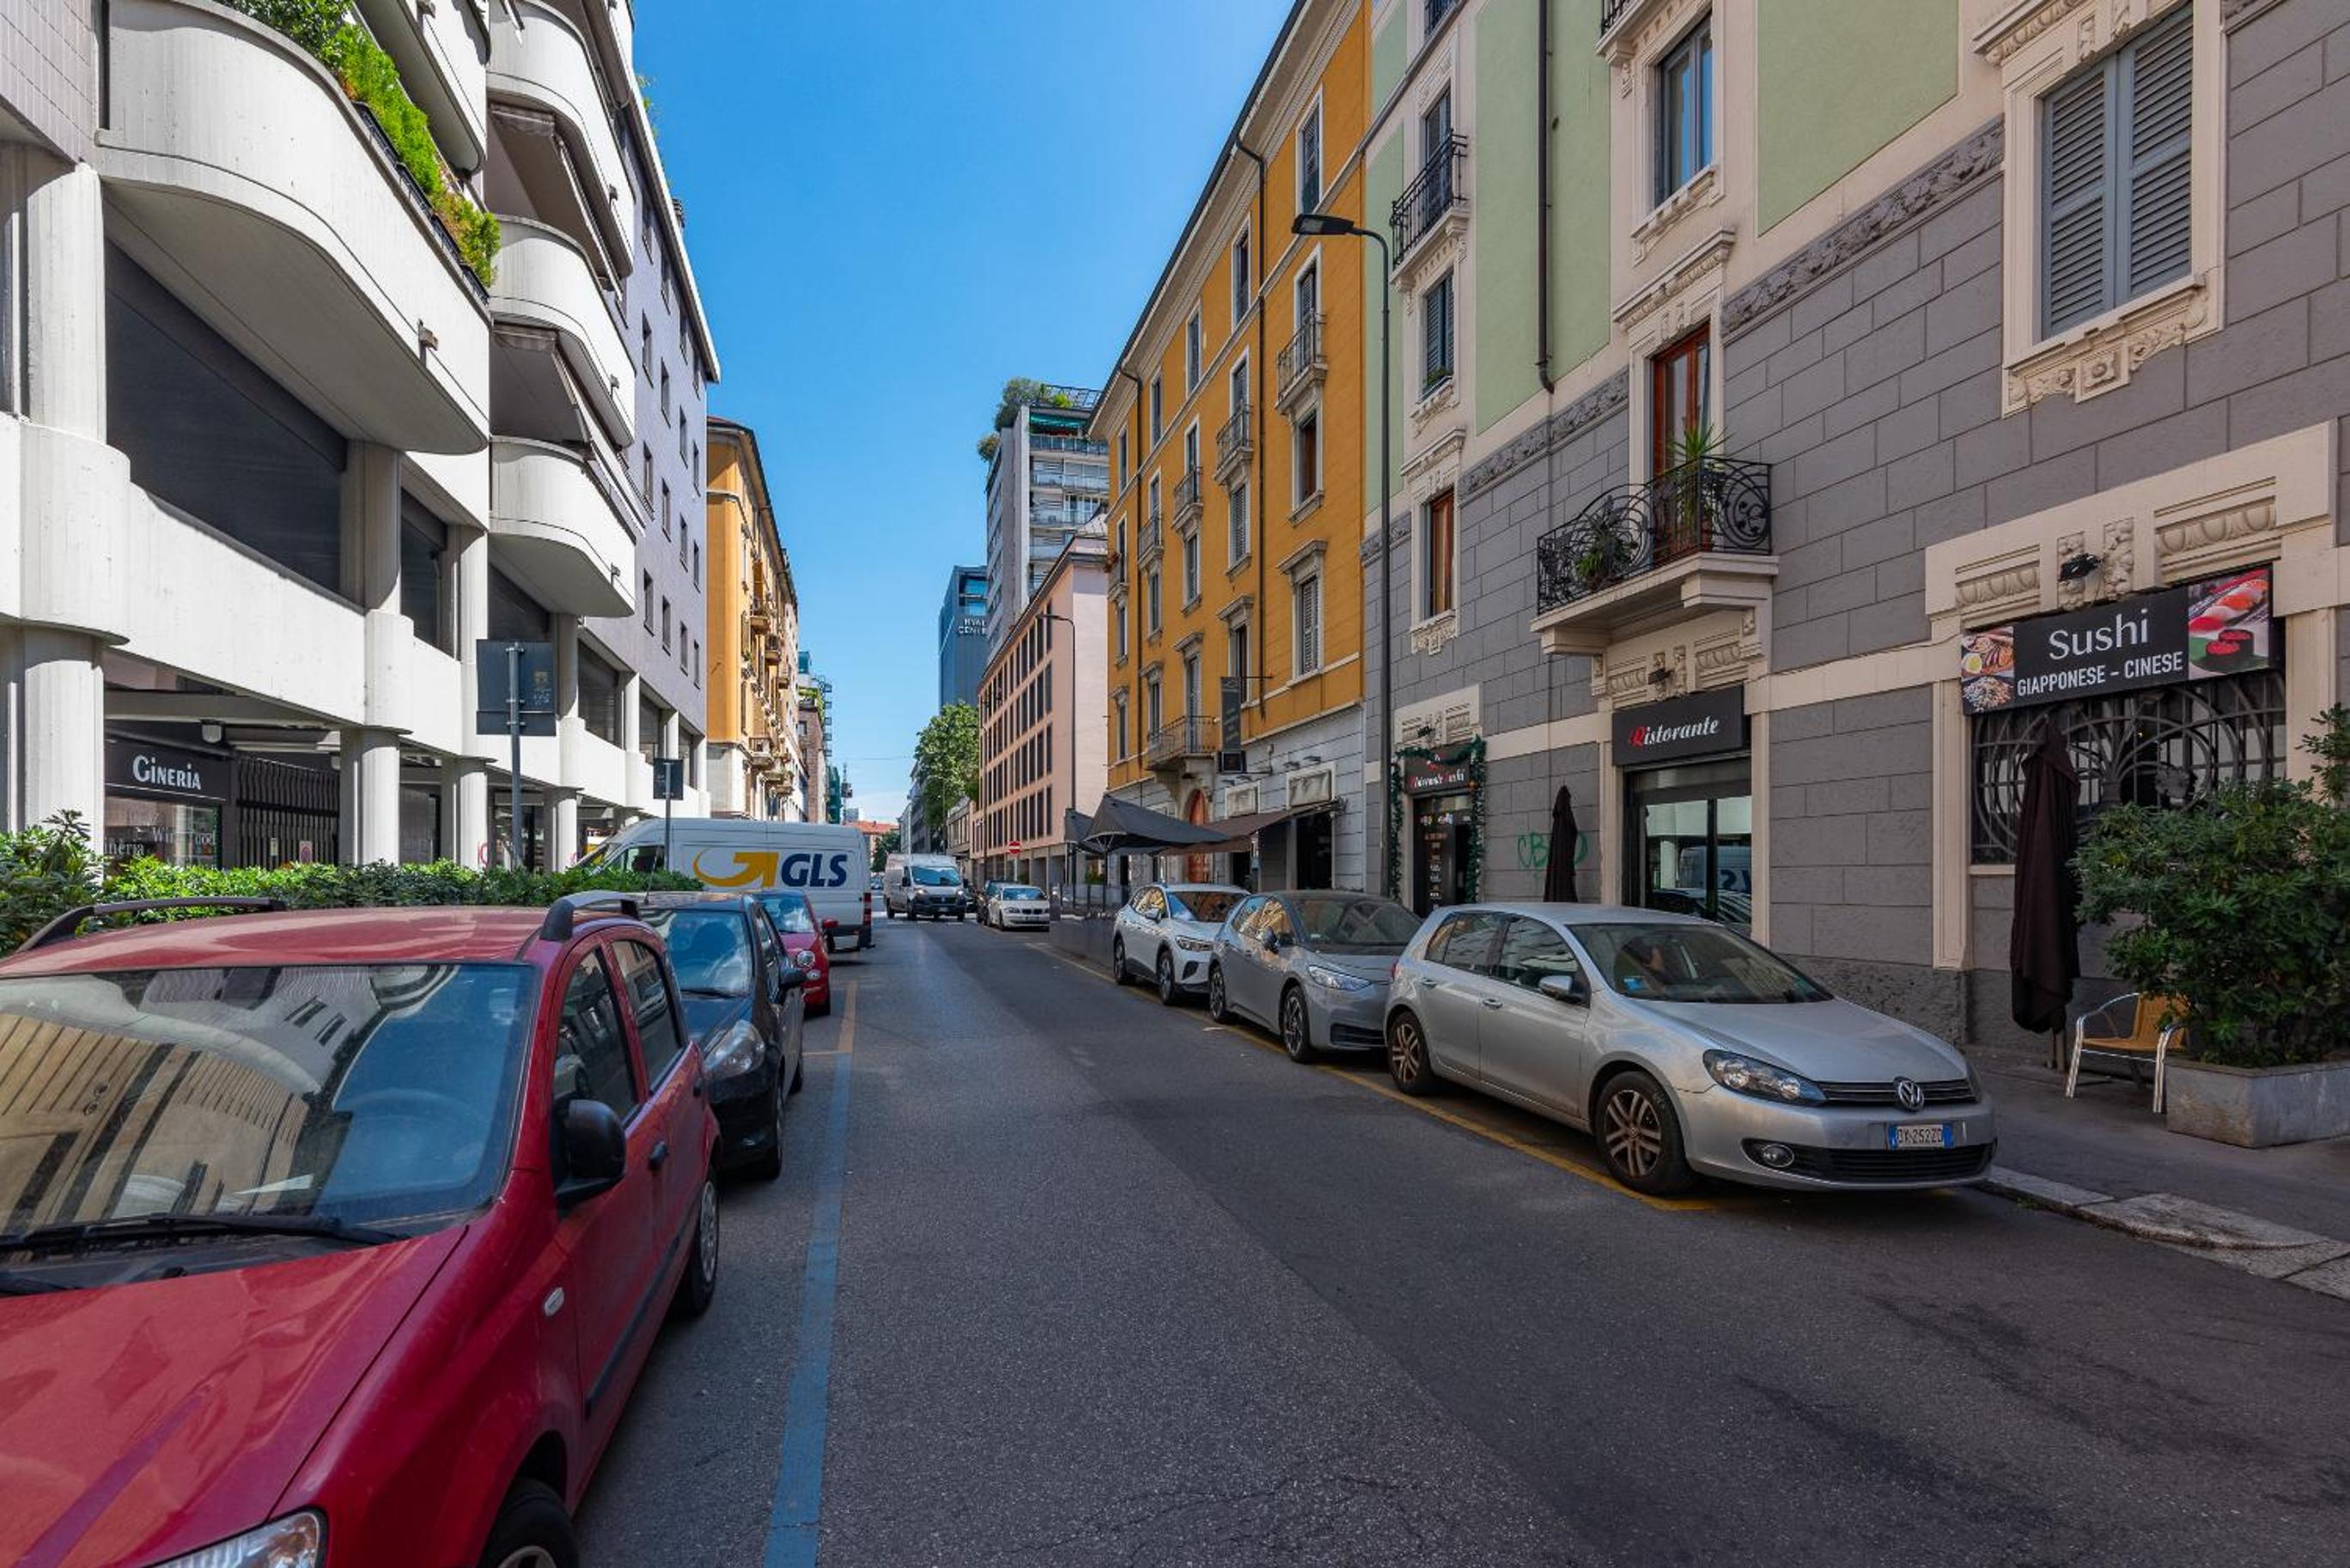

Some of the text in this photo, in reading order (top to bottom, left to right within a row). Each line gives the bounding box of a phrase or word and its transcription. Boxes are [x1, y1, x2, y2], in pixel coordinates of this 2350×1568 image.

[2049, 608, 2148, 660] Sushi
[2017, 665, 2106, 696] GIAPPONESE
[2124, 651, 2184, 679] CINESE
[1629, 715, 1720, 748] Ristorante
[781, 853, 848, 887] GLS
